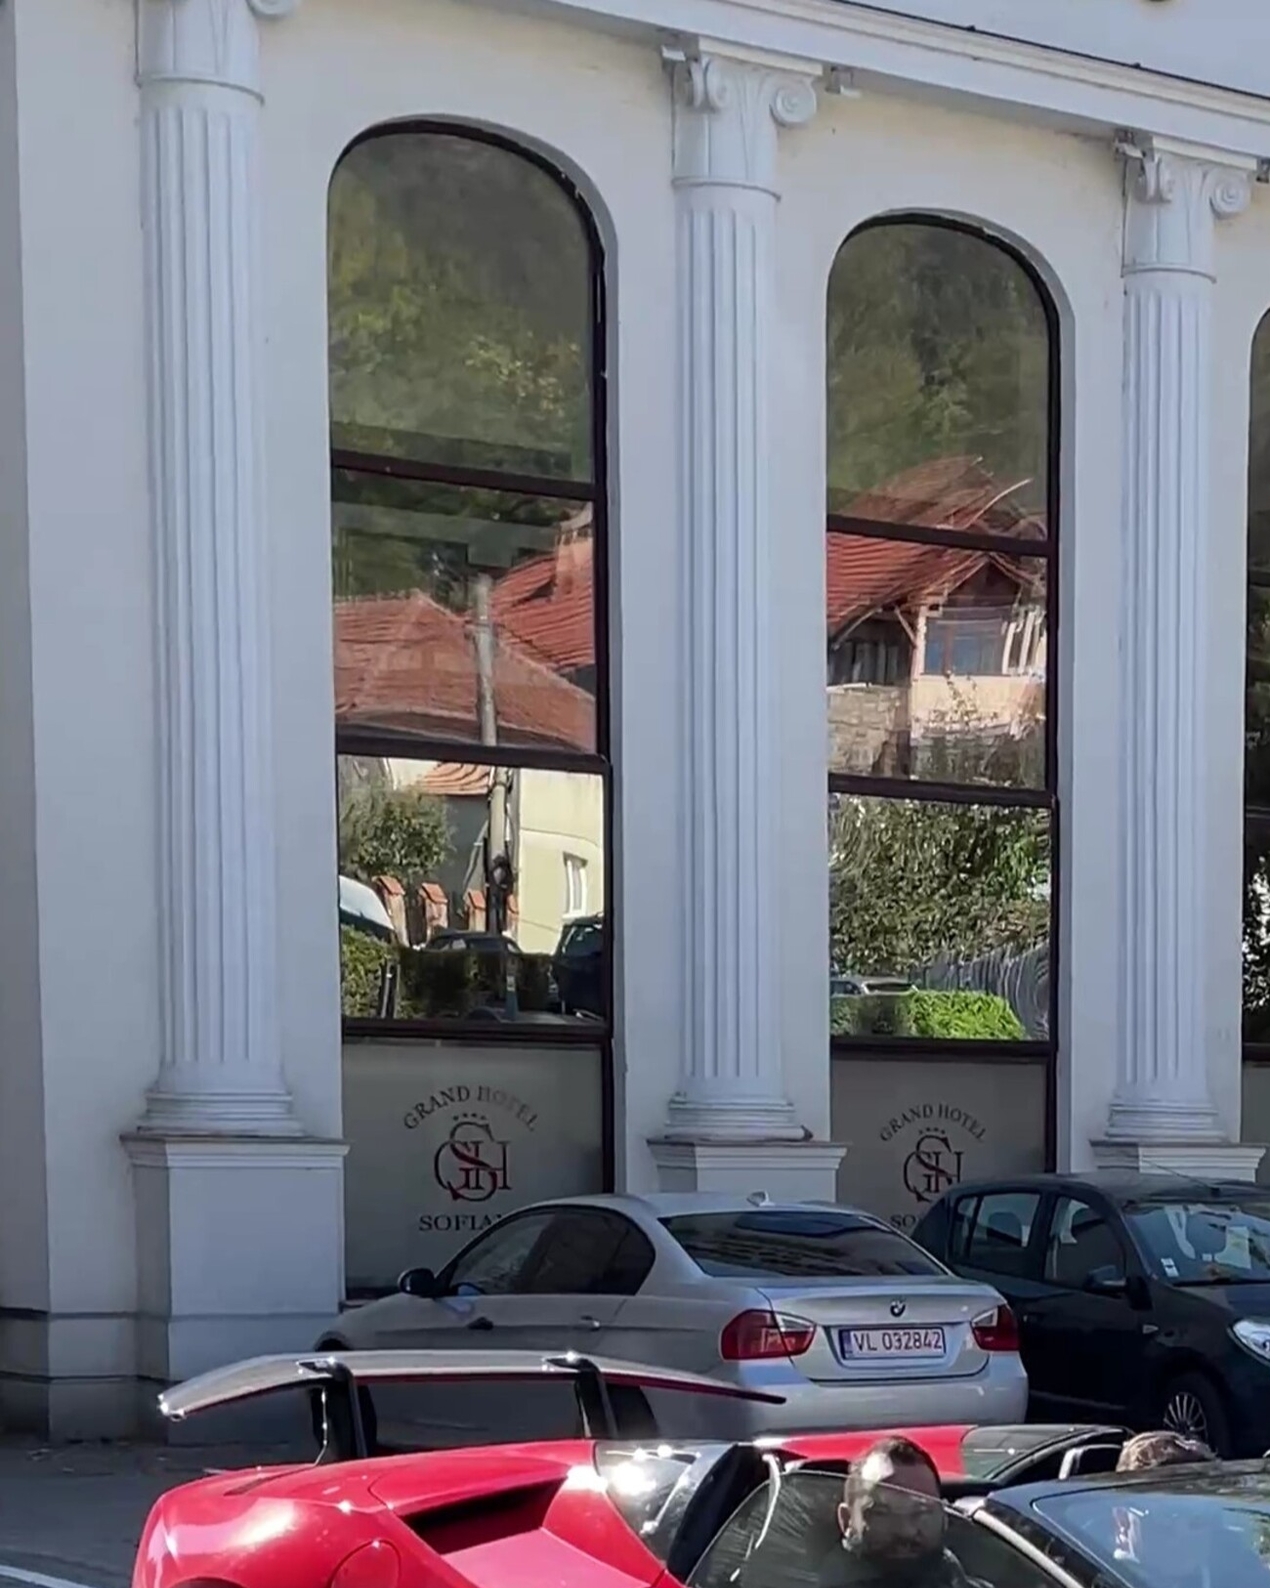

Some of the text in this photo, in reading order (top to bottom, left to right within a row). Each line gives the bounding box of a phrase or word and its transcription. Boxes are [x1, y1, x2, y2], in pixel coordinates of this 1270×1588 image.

[403, 1085, 539, 1132] GRAND HOTEL
[879, 1102, 988, 1143] GRAND HOTEL
[418, 1214, 502, 1232] SOFIA
[853, 1330, 943, 1352] VL 032842
